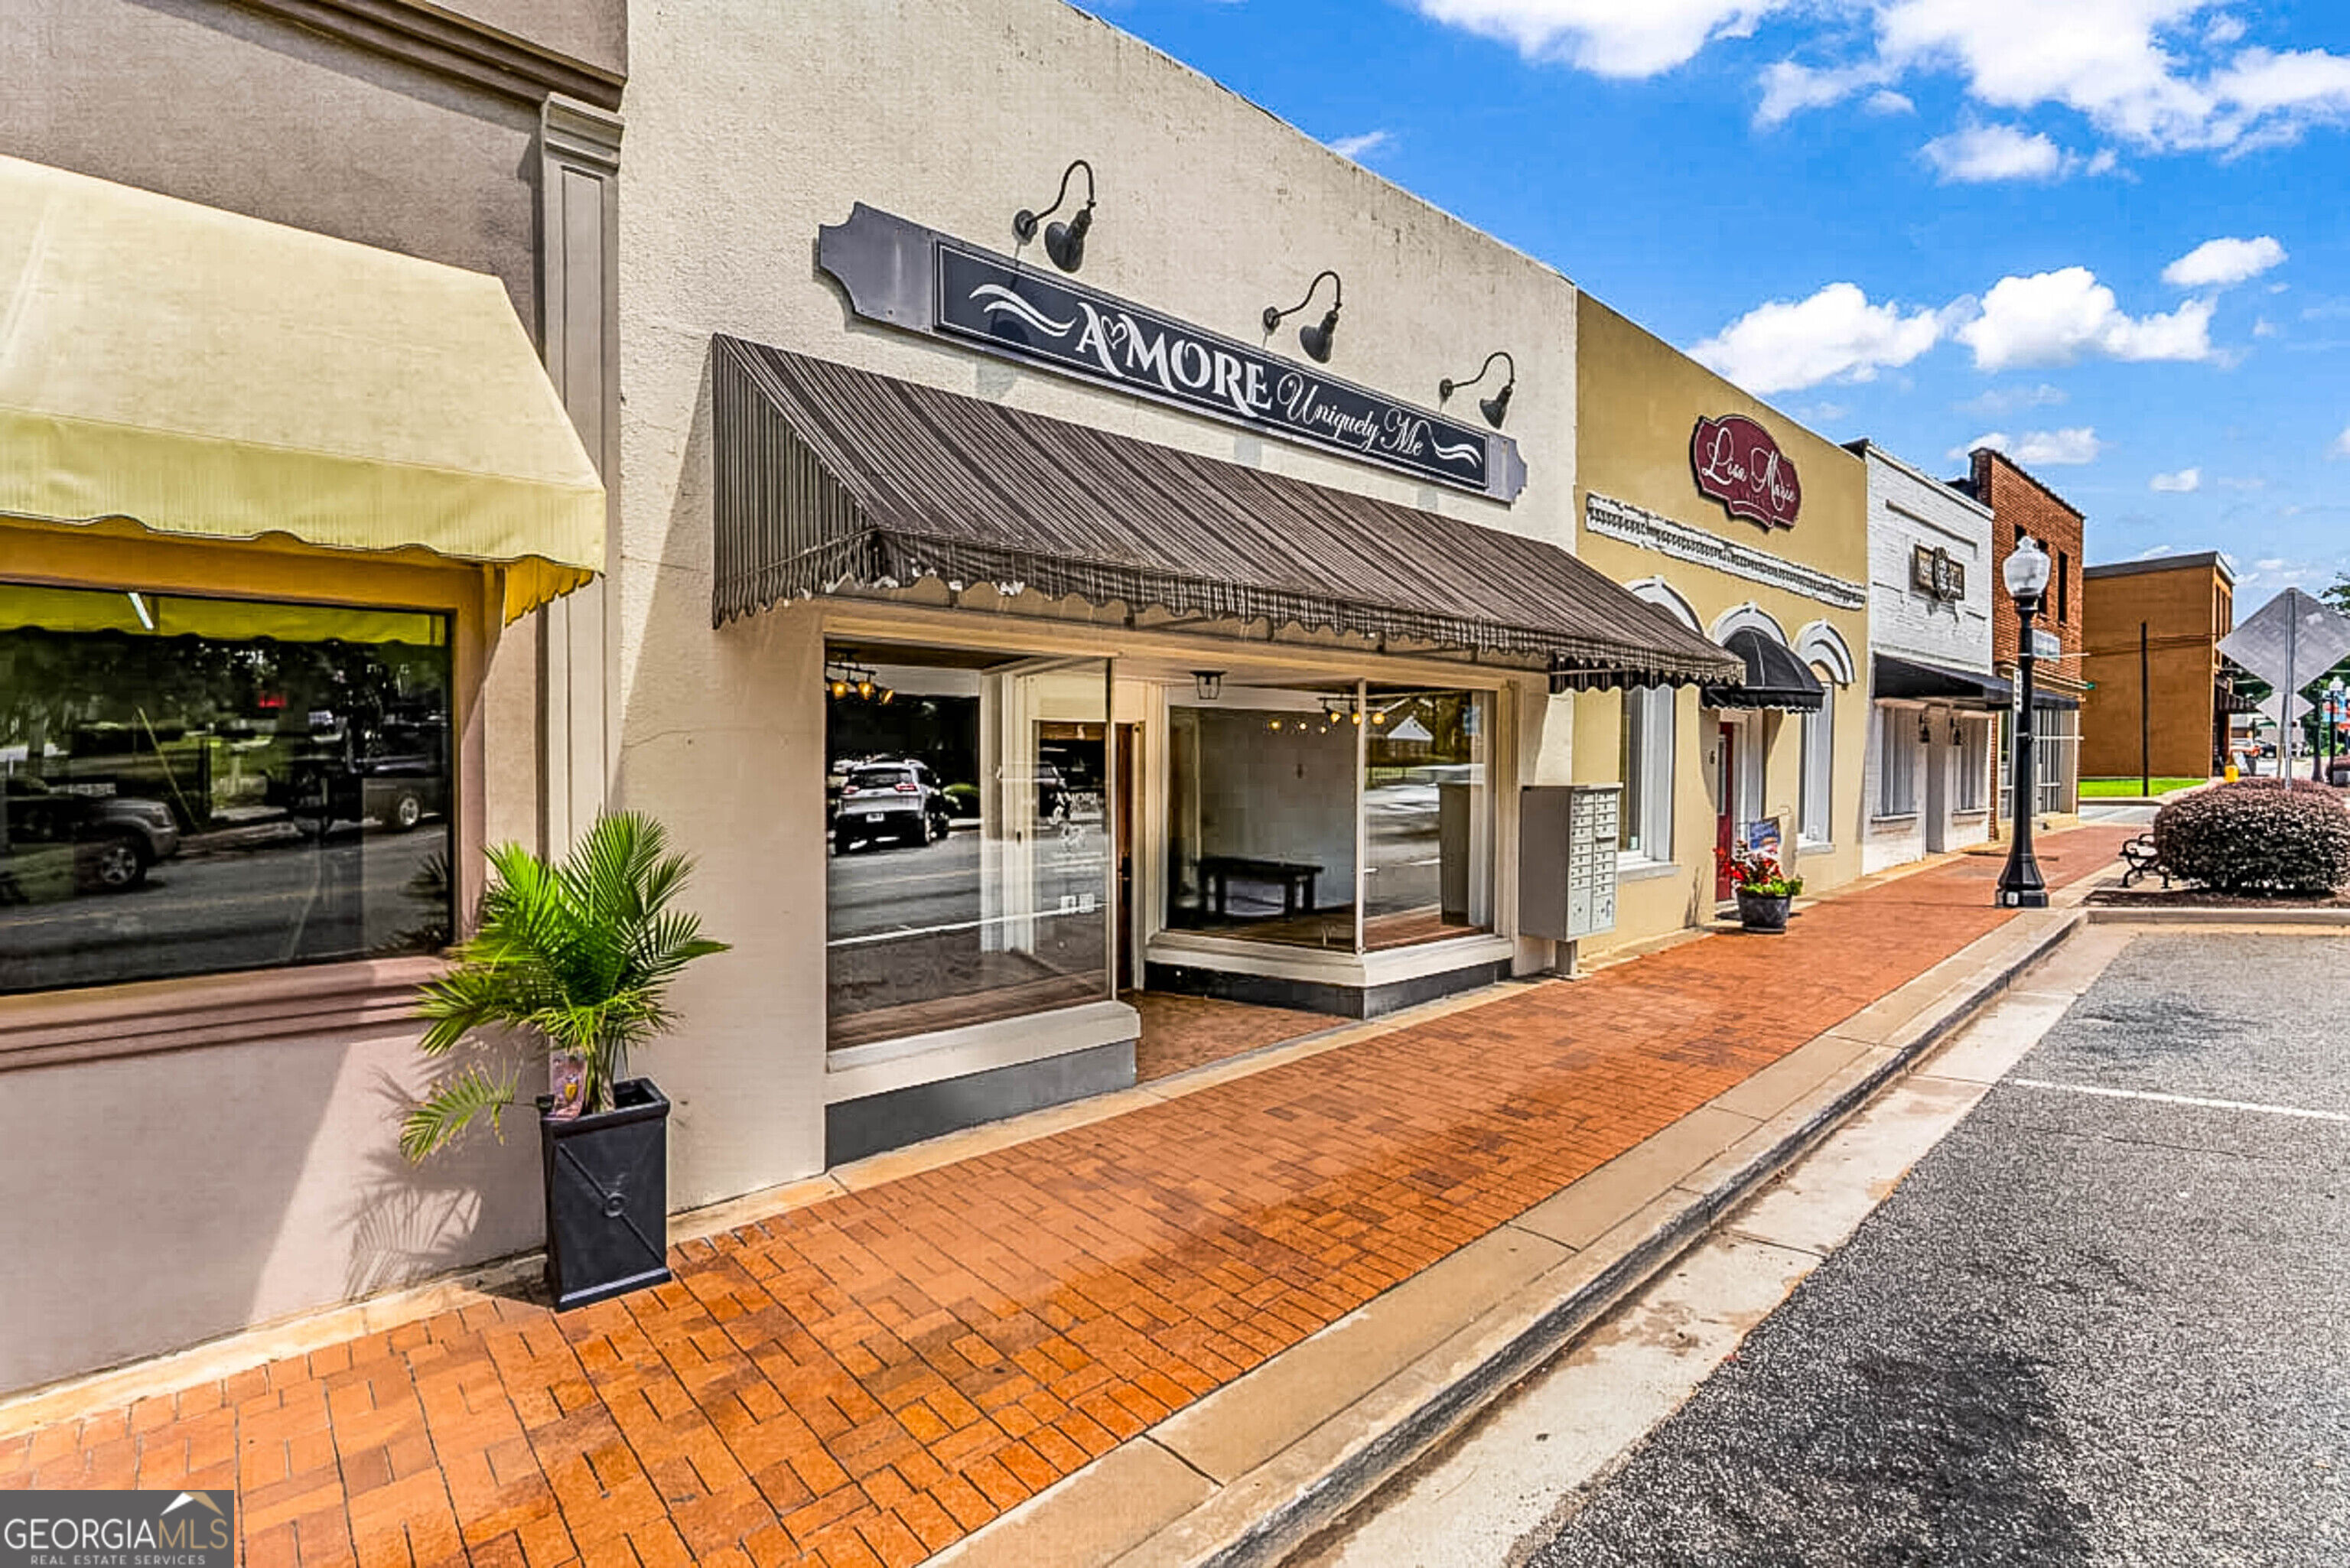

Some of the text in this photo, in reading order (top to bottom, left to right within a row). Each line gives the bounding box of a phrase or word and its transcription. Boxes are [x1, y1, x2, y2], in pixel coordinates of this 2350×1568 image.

[1076, 302, 1427, 456] AMORE Uniquely Me
